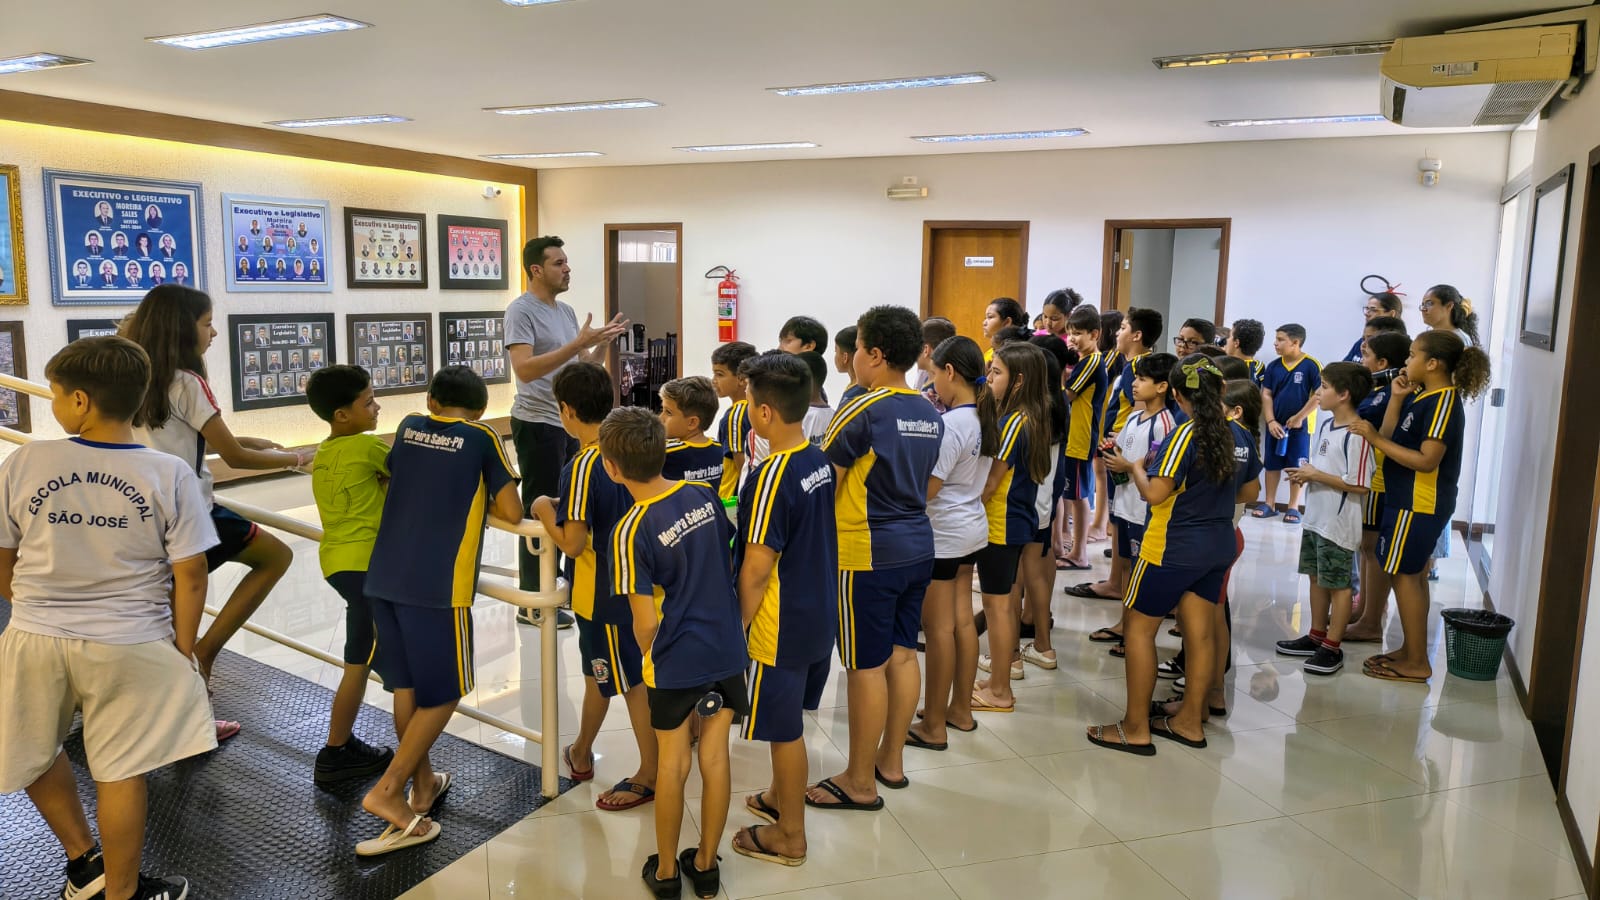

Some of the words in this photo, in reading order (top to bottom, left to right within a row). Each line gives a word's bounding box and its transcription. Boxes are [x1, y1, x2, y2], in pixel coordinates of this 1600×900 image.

[72, 190, 121, 200] EXECUTIVO
[131, 195, 183, 205] LEGISLATIVO
[115, 202, 142, 210] MOREIRA
[233, 206, 273, 217] Executivo
[280, 209, 321, 219] Legislativo
[354, 219, 382, 228] Executivo
[28, 471, 82, 516] ESCOLA
[86, 471, 154, 523] MUNICIPAL
[47, 510, 83, 525] SÃO
[86, 515, 129, 529] JOSÉ
